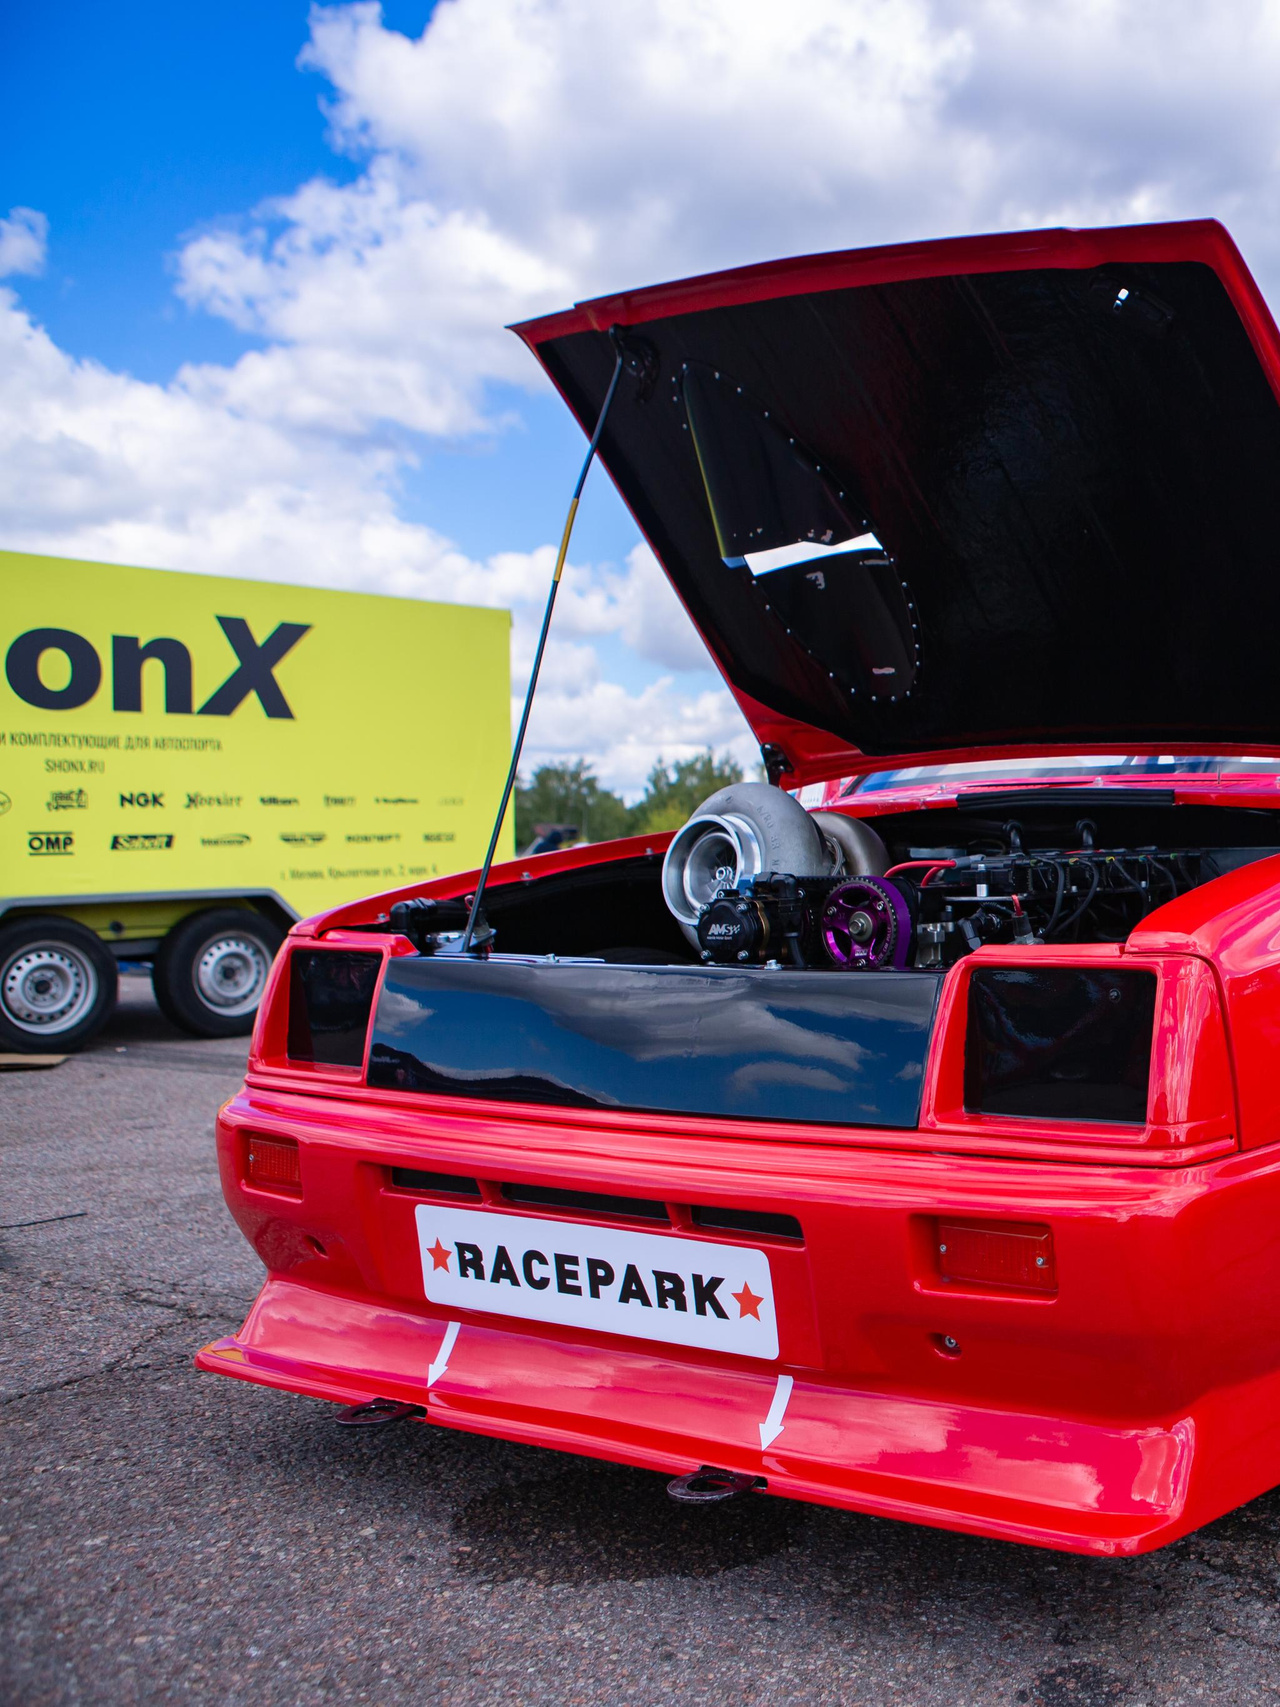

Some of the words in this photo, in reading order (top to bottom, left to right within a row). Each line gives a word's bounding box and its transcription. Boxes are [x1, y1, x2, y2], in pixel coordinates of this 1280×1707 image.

[4, 614, 314, 721] onX
[10, 731, 120, 750] КОМПЛЕКТУЮЩИЕ
[119, 792, 165, 808] NGK
[28, 836, 73, 851] OMP
[455, 1241, 731, 1320] RACEPARK
